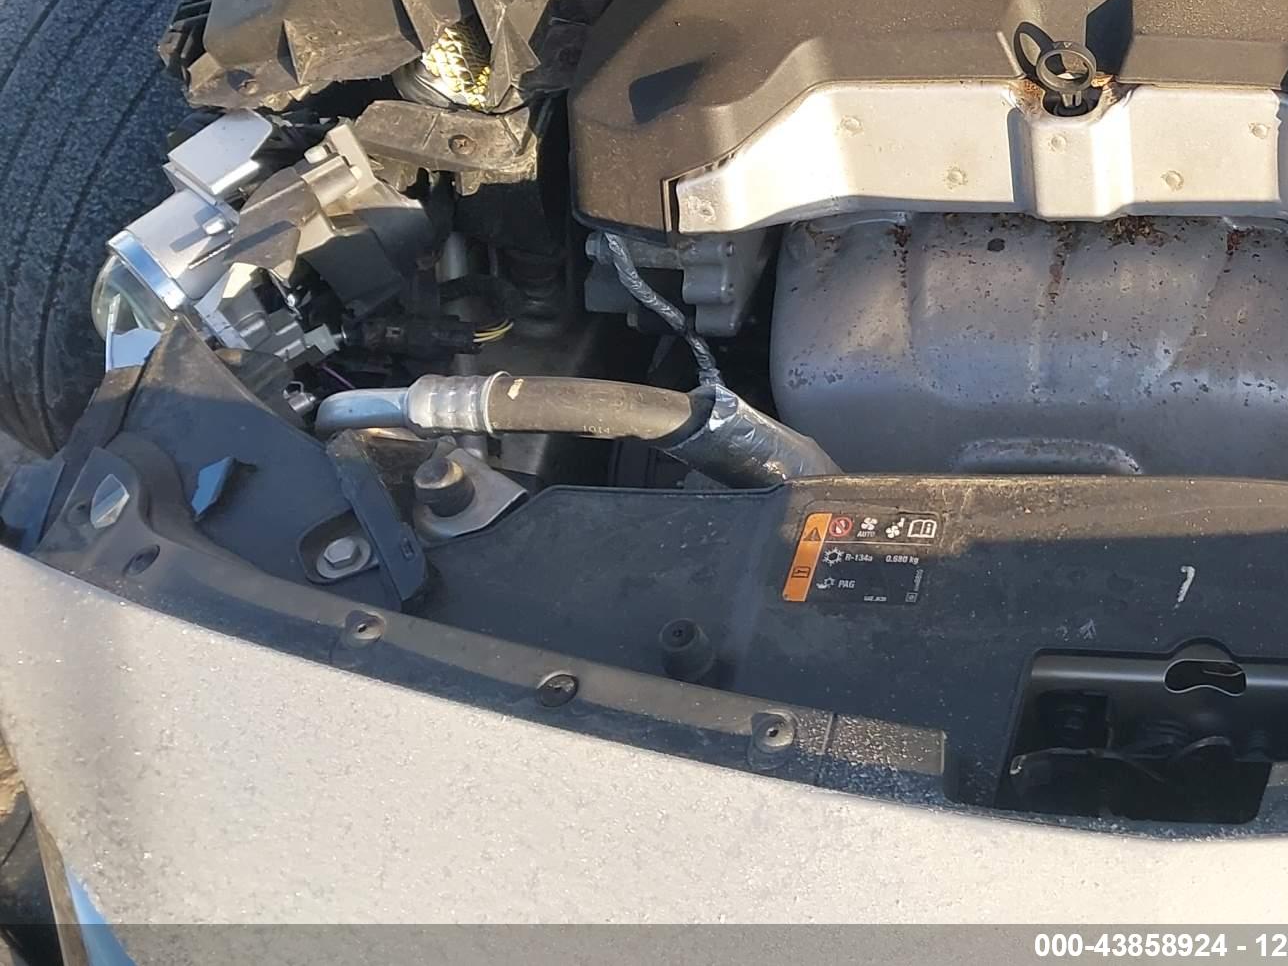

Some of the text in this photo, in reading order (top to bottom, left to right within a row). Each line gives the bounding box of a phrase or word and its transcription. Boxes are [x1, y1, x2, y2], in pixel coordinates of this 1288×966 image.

[857, 530, 876, 538] AUTO
[845, 553, 873, 562] R-134a
[908, 556, 919, 565] kg
[838, 580, 856, 589] PAG
